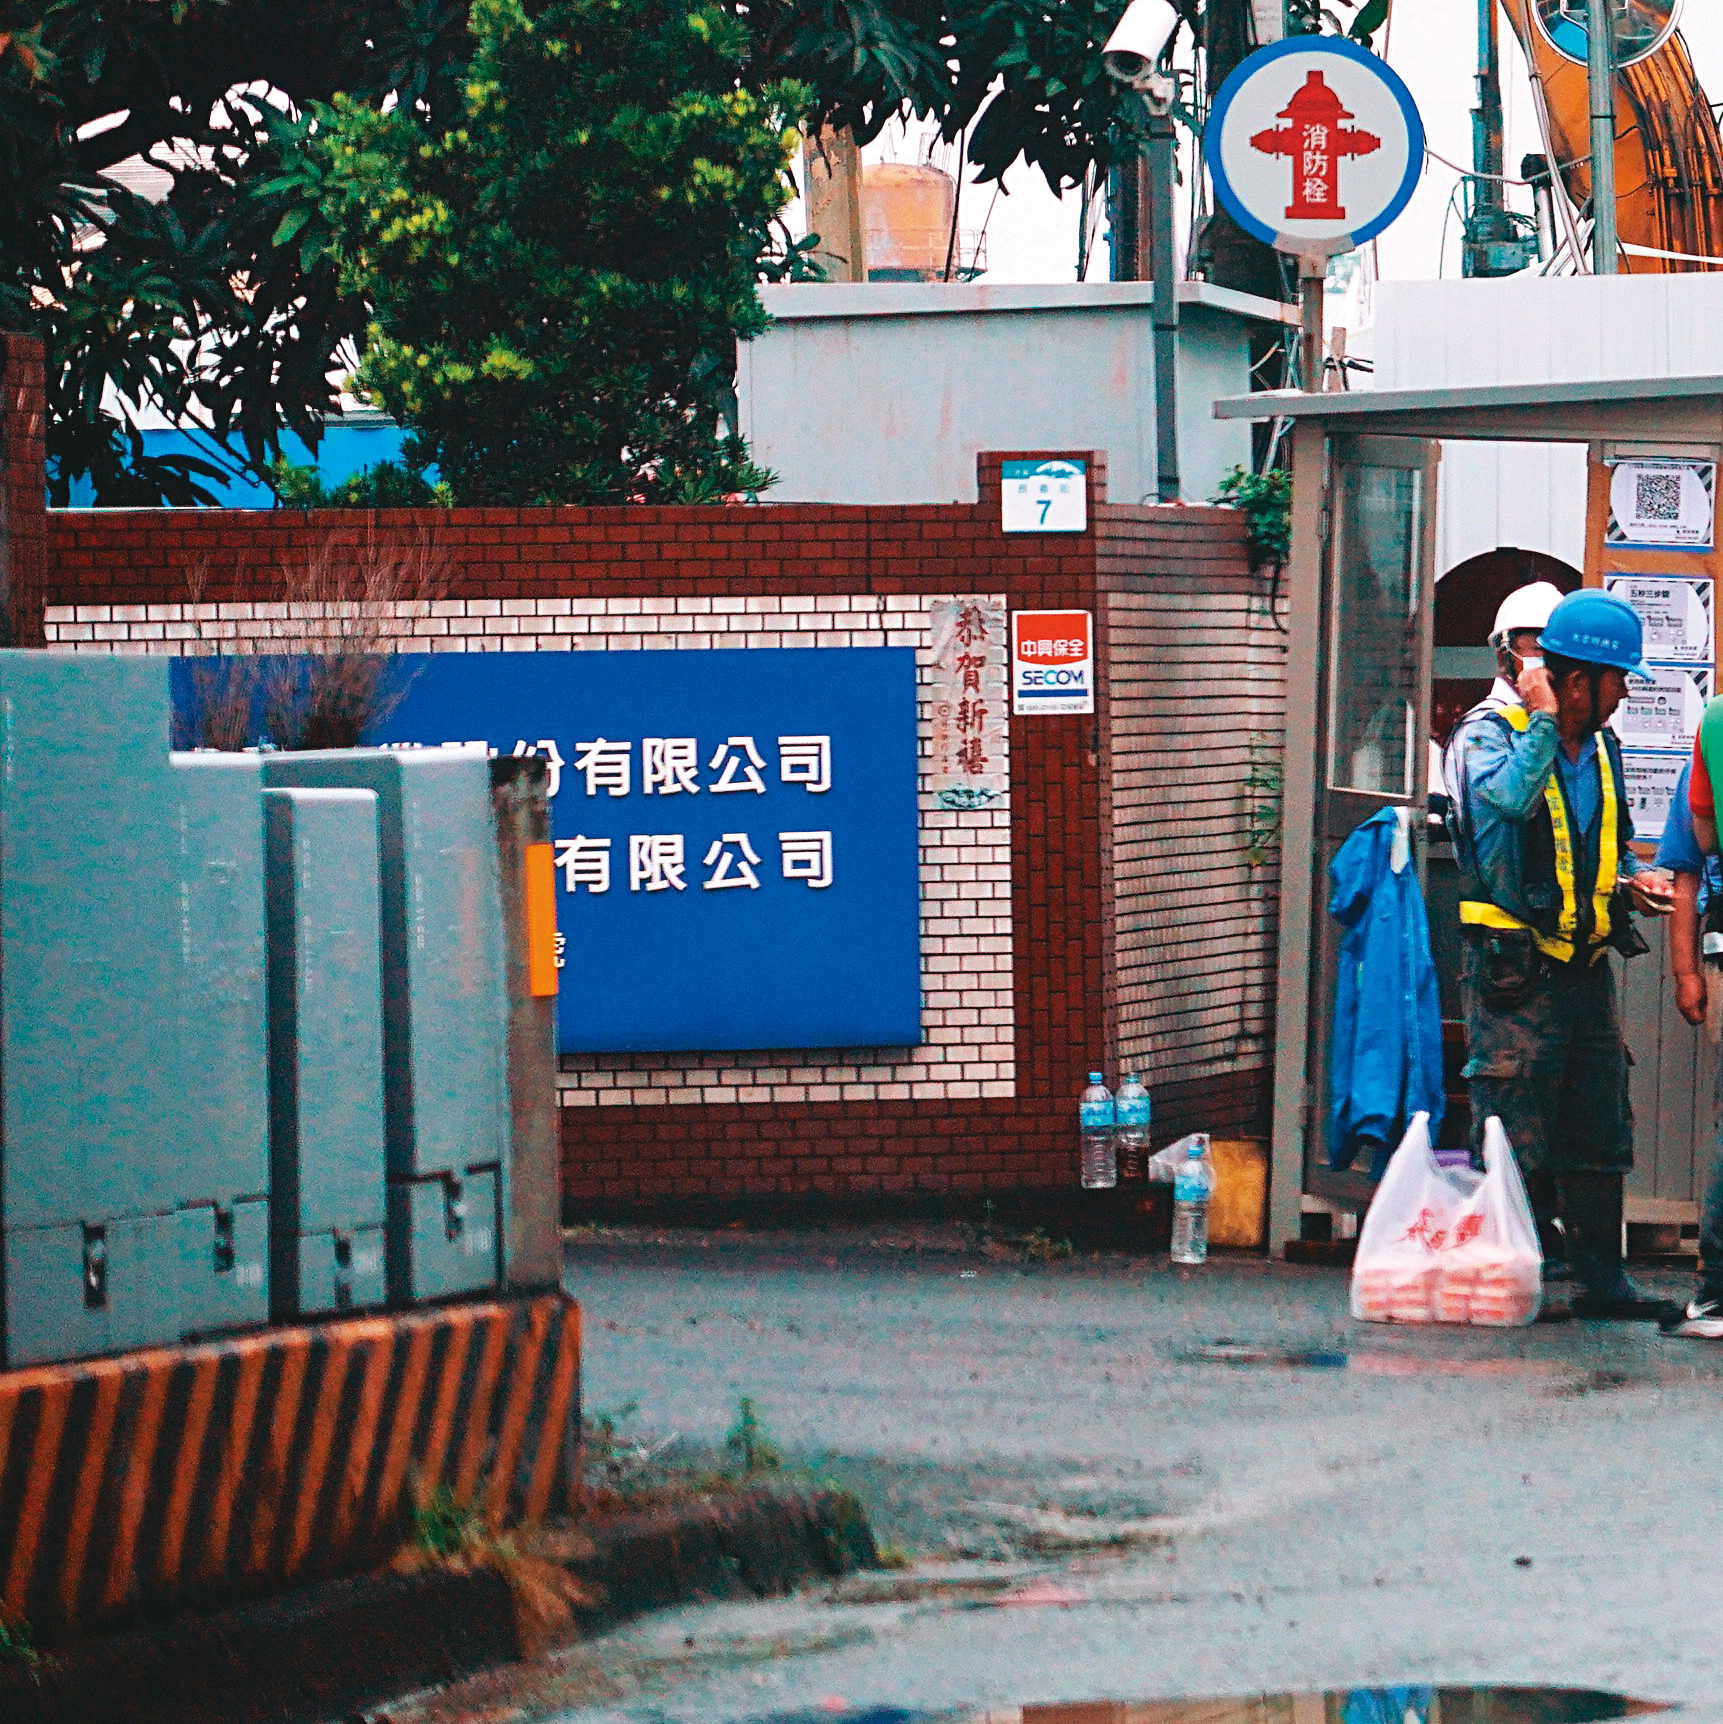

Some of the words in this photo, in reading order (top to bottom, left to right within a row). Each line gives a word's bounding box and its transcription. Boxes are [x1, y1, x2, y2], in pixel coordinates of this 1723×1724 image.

[1302, 123, 1329, 203] 消防栓
[1037, 500, 1051, 525] 7
[1020, 639, 1084, 658] 中興保全
[1022, 670, 1084, 685] SECOM
[956, 606, 989, 774] 恭賀新禧
[378, 735, 832, 799] 份有限公司
[554, 831, 833, 893] 有限公司
